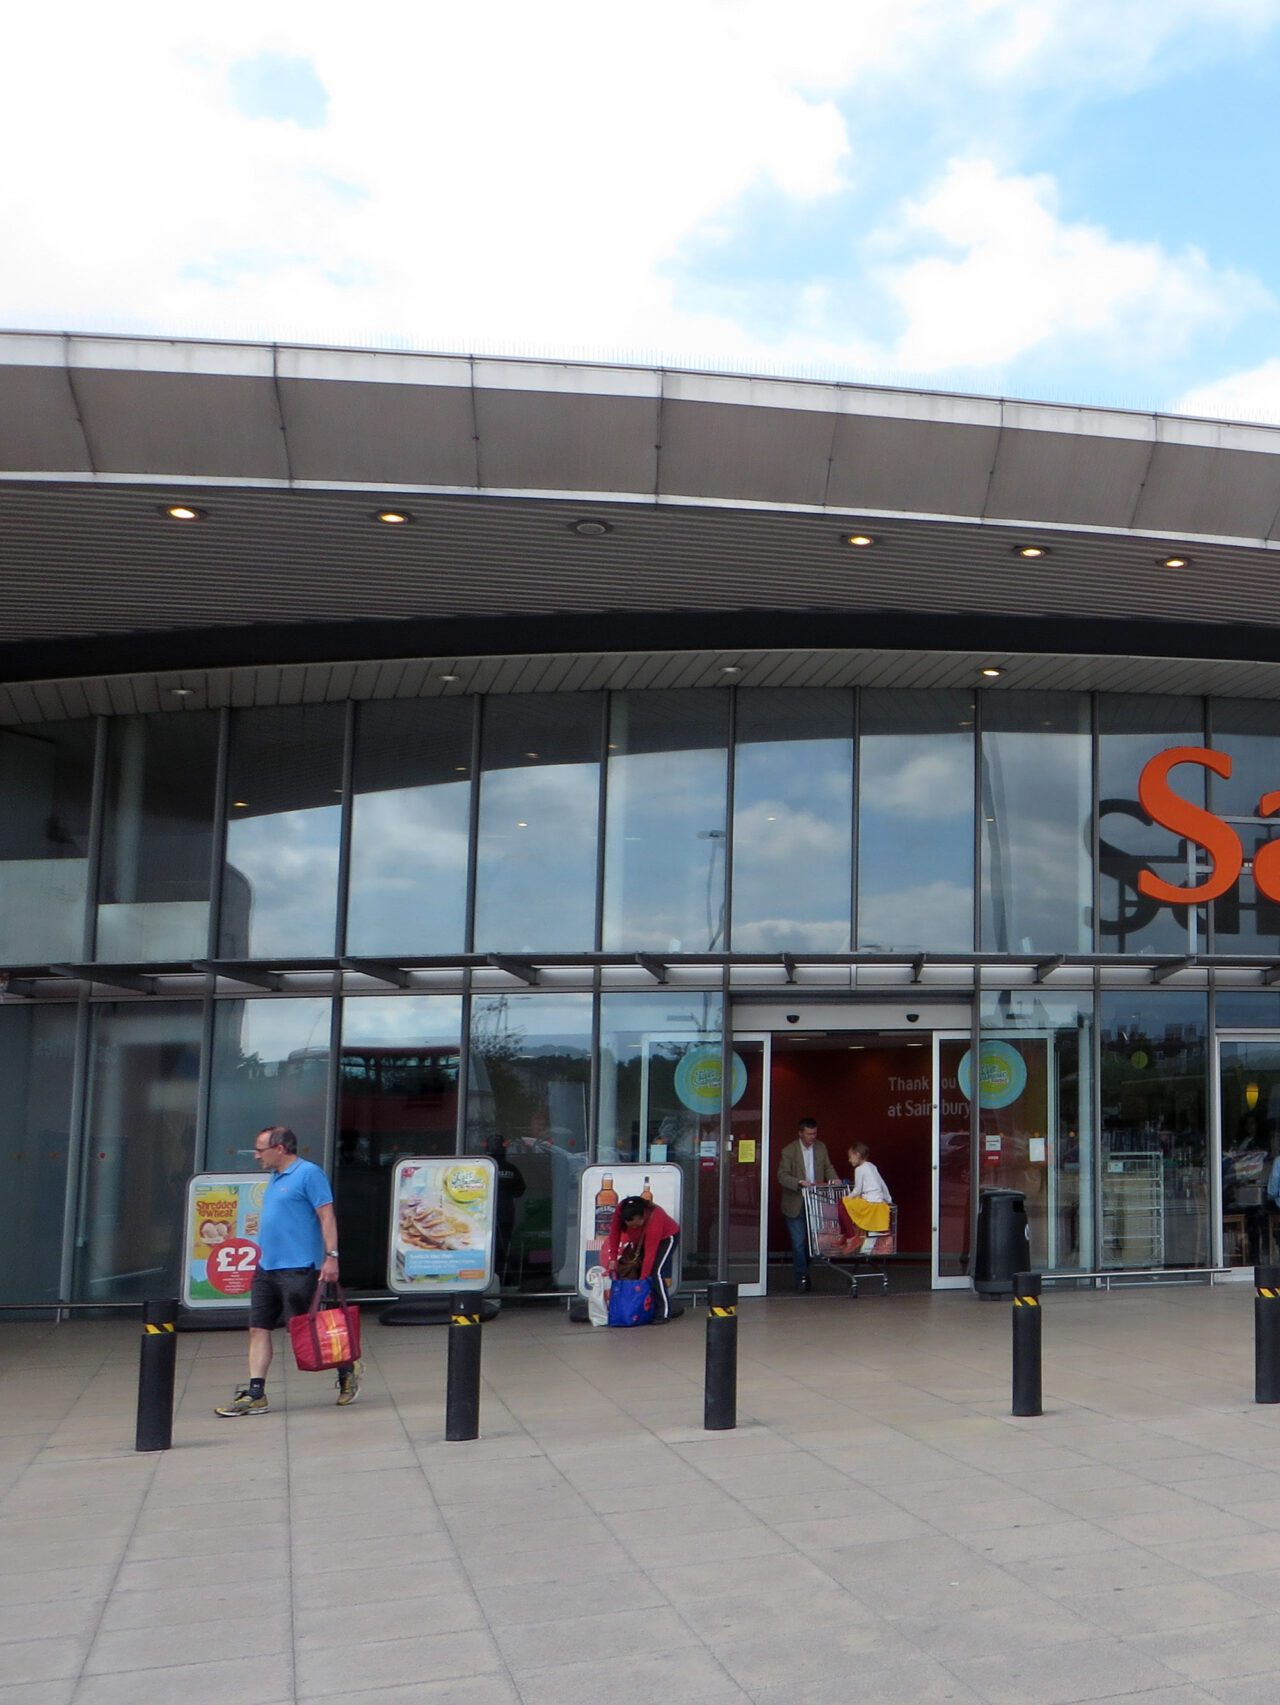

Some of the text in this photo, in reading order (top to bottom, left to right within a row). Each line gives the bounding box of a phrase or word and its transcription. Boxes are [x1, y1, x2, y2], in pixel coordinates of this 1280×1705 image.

[888, 1076, 929, 1091] Thank
[888, 1104, 902, 1117] at
[196, 1200, 237, 1211] Shredded
[216, 1247, 256, 1272] £2
